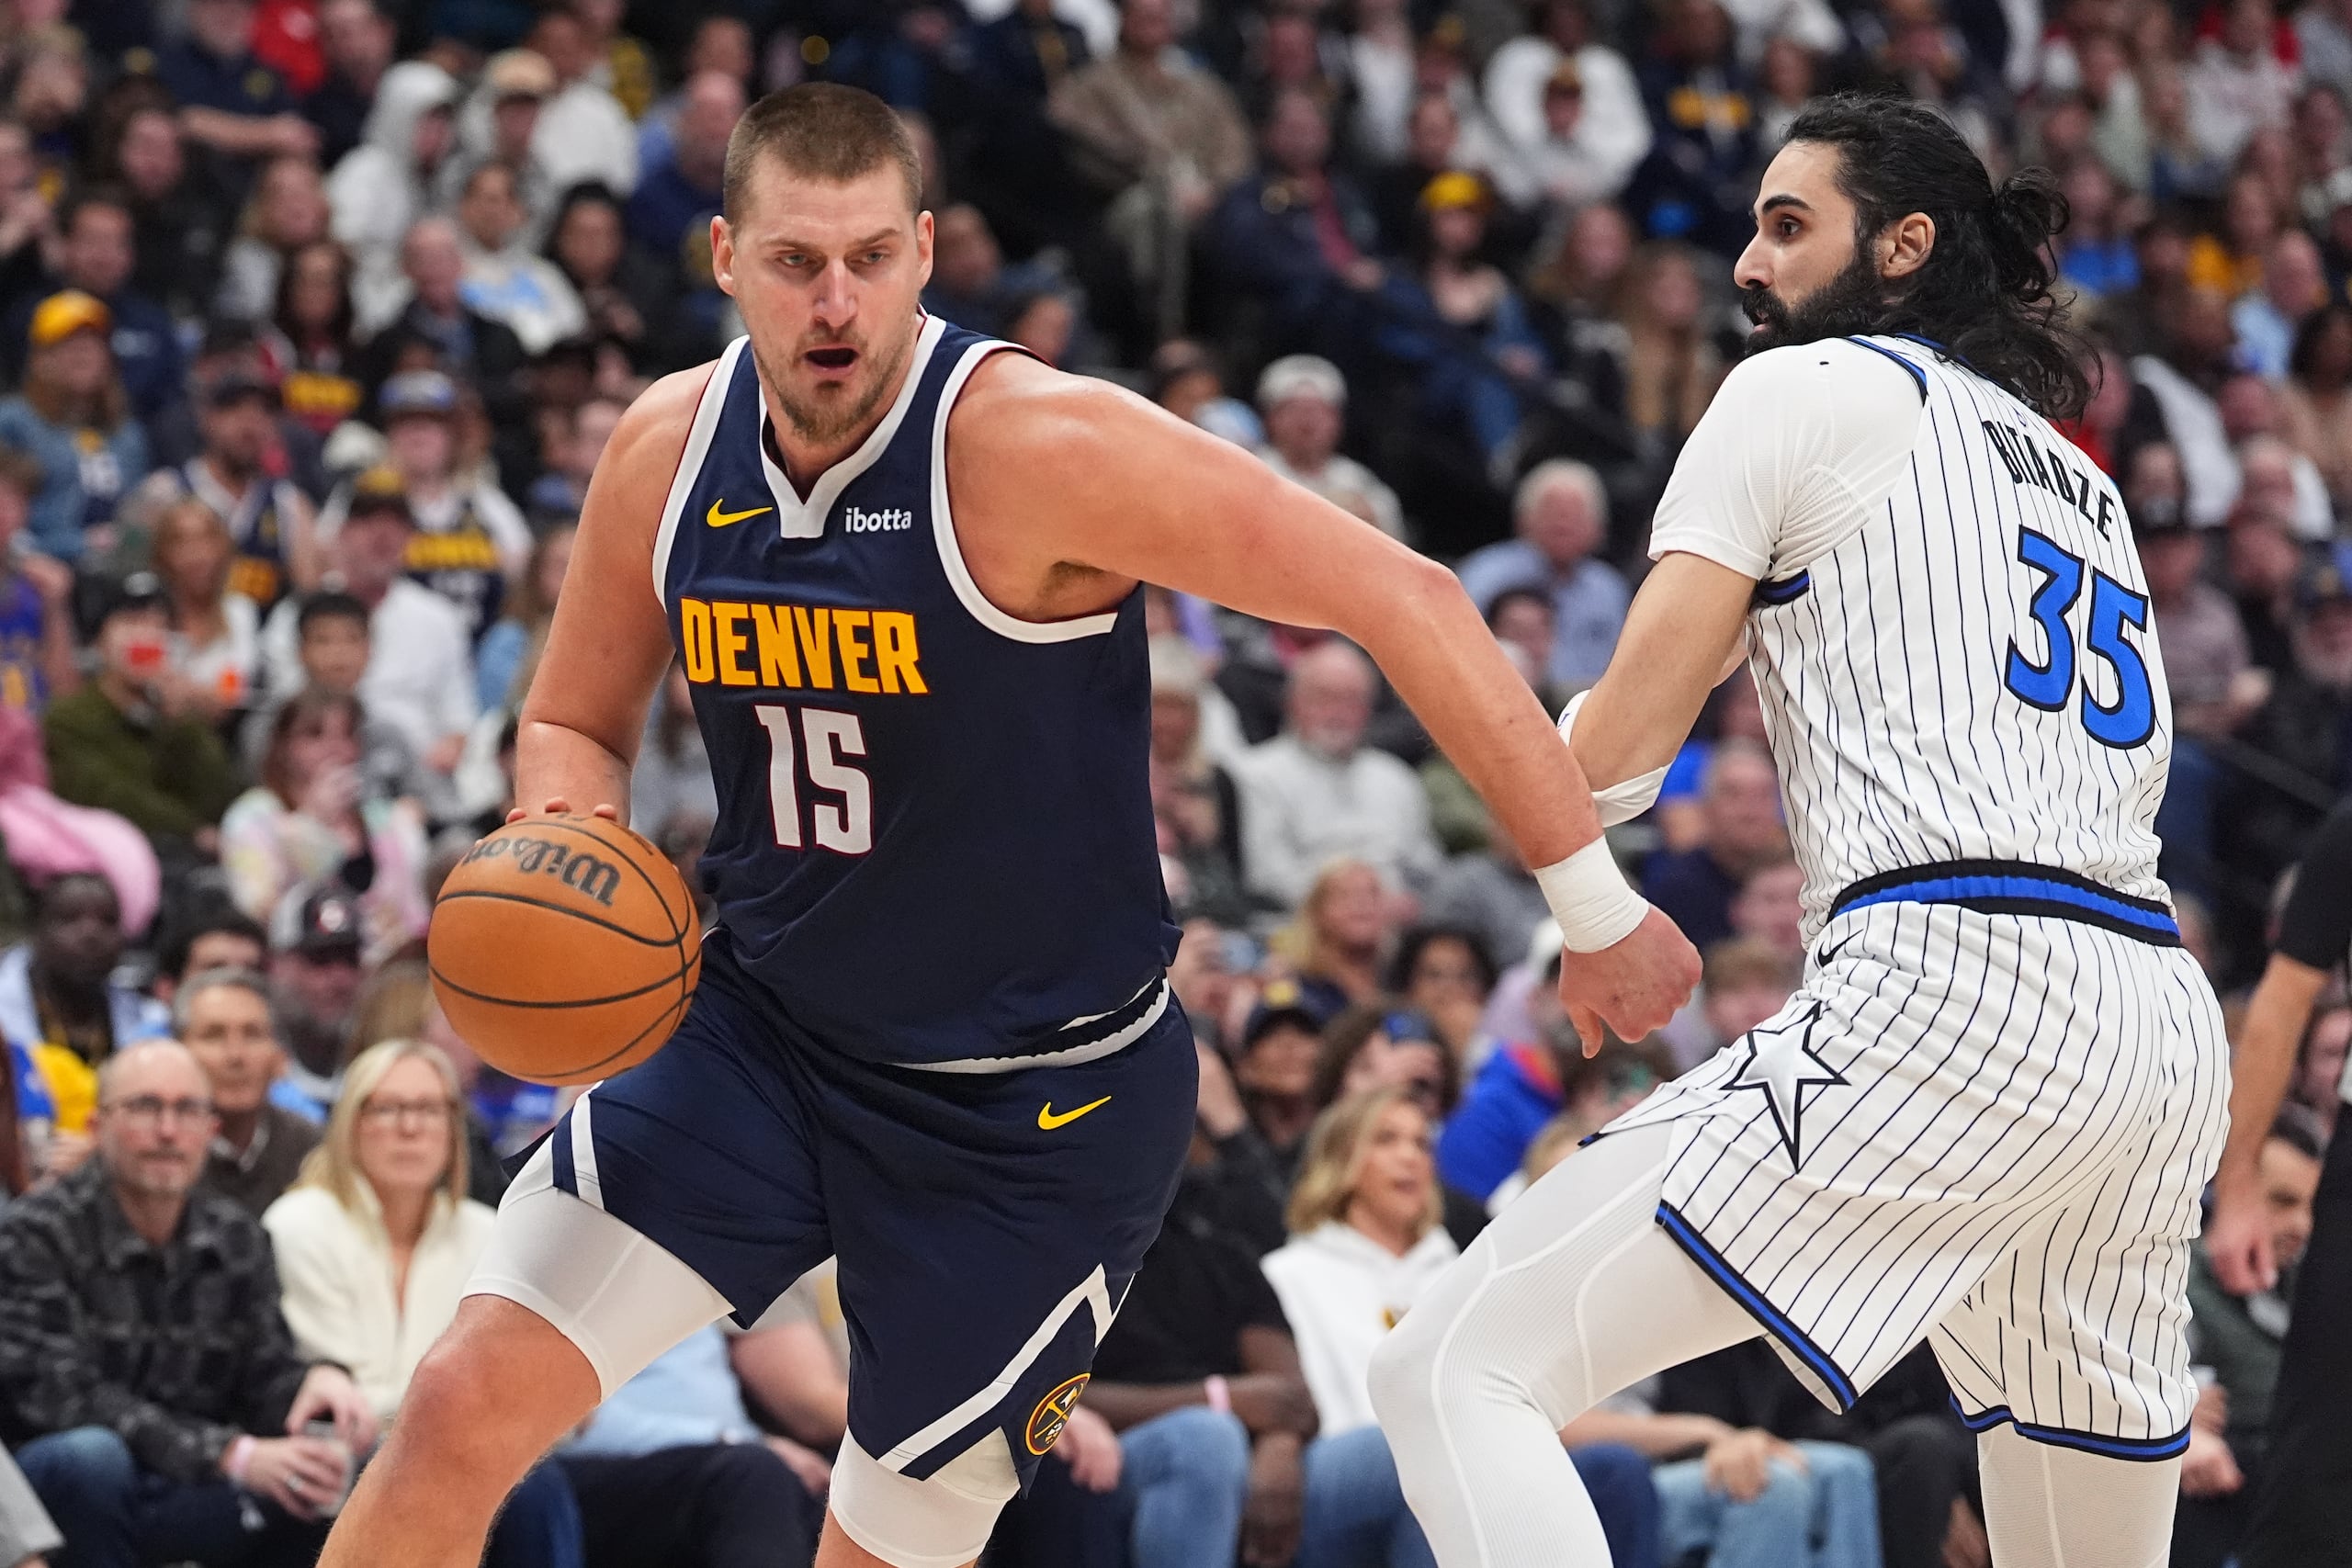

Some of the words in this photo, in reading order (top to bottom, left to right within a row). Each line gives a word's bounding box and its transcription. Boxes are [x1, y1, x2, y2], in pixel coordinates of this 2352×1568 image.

[845, 506, 912, 533] ibotta
[1981, 420, 2114, 542] BITADZE
[680, 596, 930, 695] DENVER
[2004, 524, 2155, 750] 35
[752, 703, 874, 857] 15
